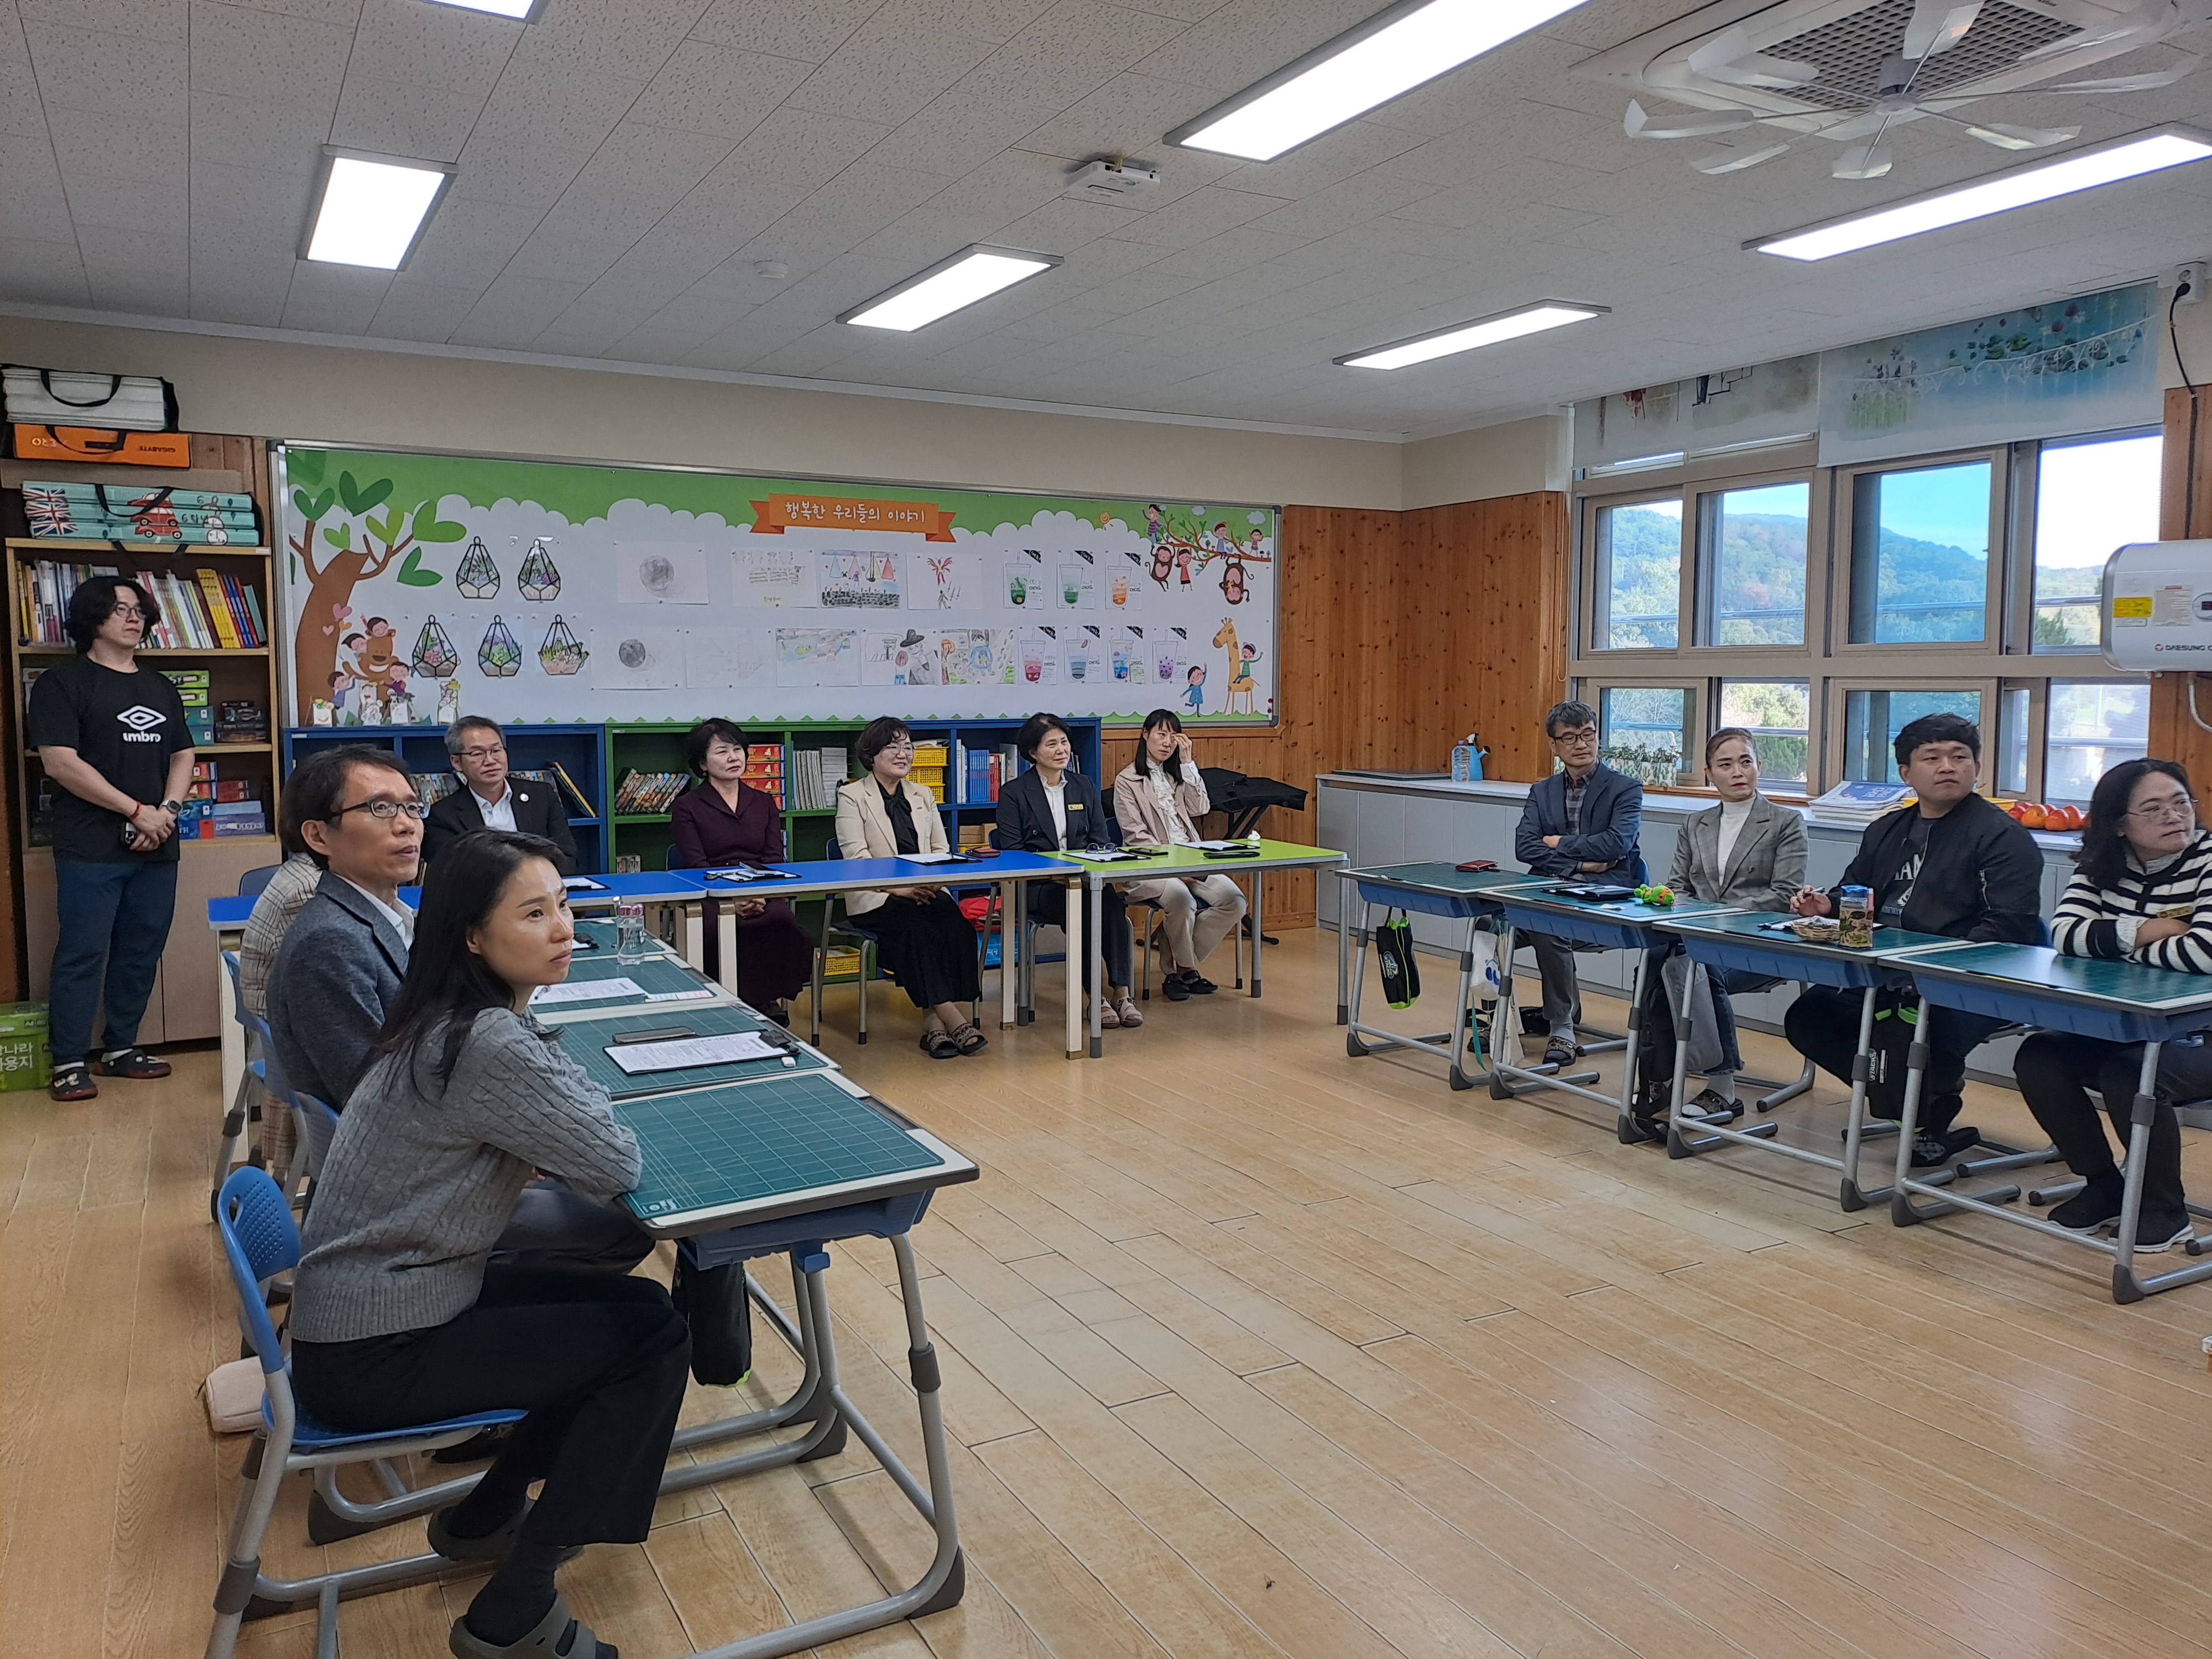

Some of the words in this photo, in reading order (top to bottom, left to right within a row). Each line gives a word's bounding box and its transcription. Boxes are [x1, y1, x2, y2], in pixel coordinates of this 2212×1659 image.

[785, 501, 826, 521] 행복한
[832, 503, 880, 524] 우리들의
[888, 509, 925, 523] 이야기
[122, 731, 161, 743] umbro
